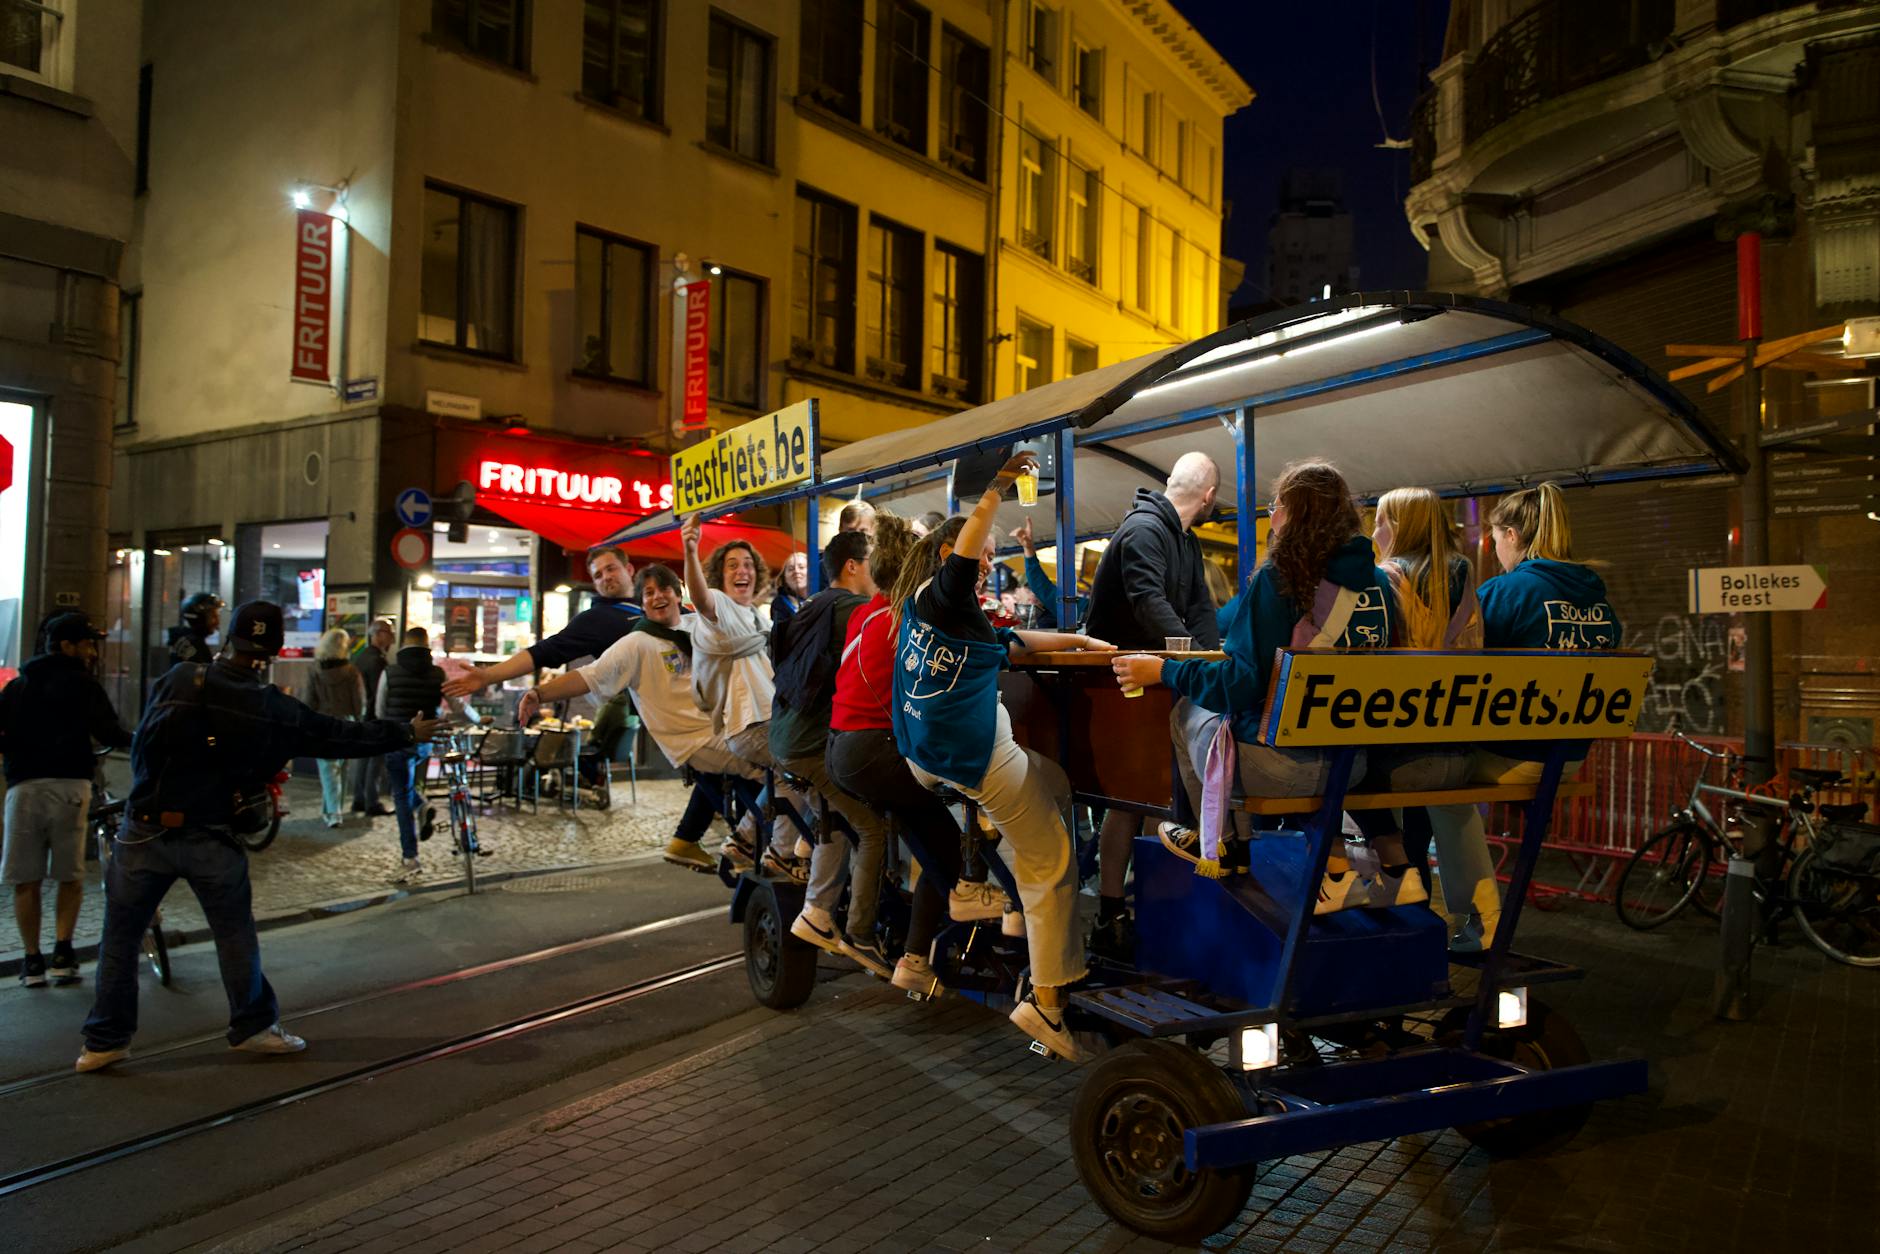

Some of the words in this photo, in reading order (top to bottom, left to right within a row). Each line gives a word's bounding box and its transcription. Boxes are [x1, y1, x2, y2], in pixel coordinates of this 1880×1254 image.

[297, 222, 328, 371] FRITUUR
[687, 289, 707, 415] FRITUUR
[480, 461, 622, 504] FRITUUR
[675, 414, 805, 510] FeestFiets.be
[1721, 573, 1800, 590] Bollekes
[1721, 591, 1771, 607] feest
[1560, 604, 1604, 621] SOCIO
[1296, 673, 1633, 729] FeestFiets.be
